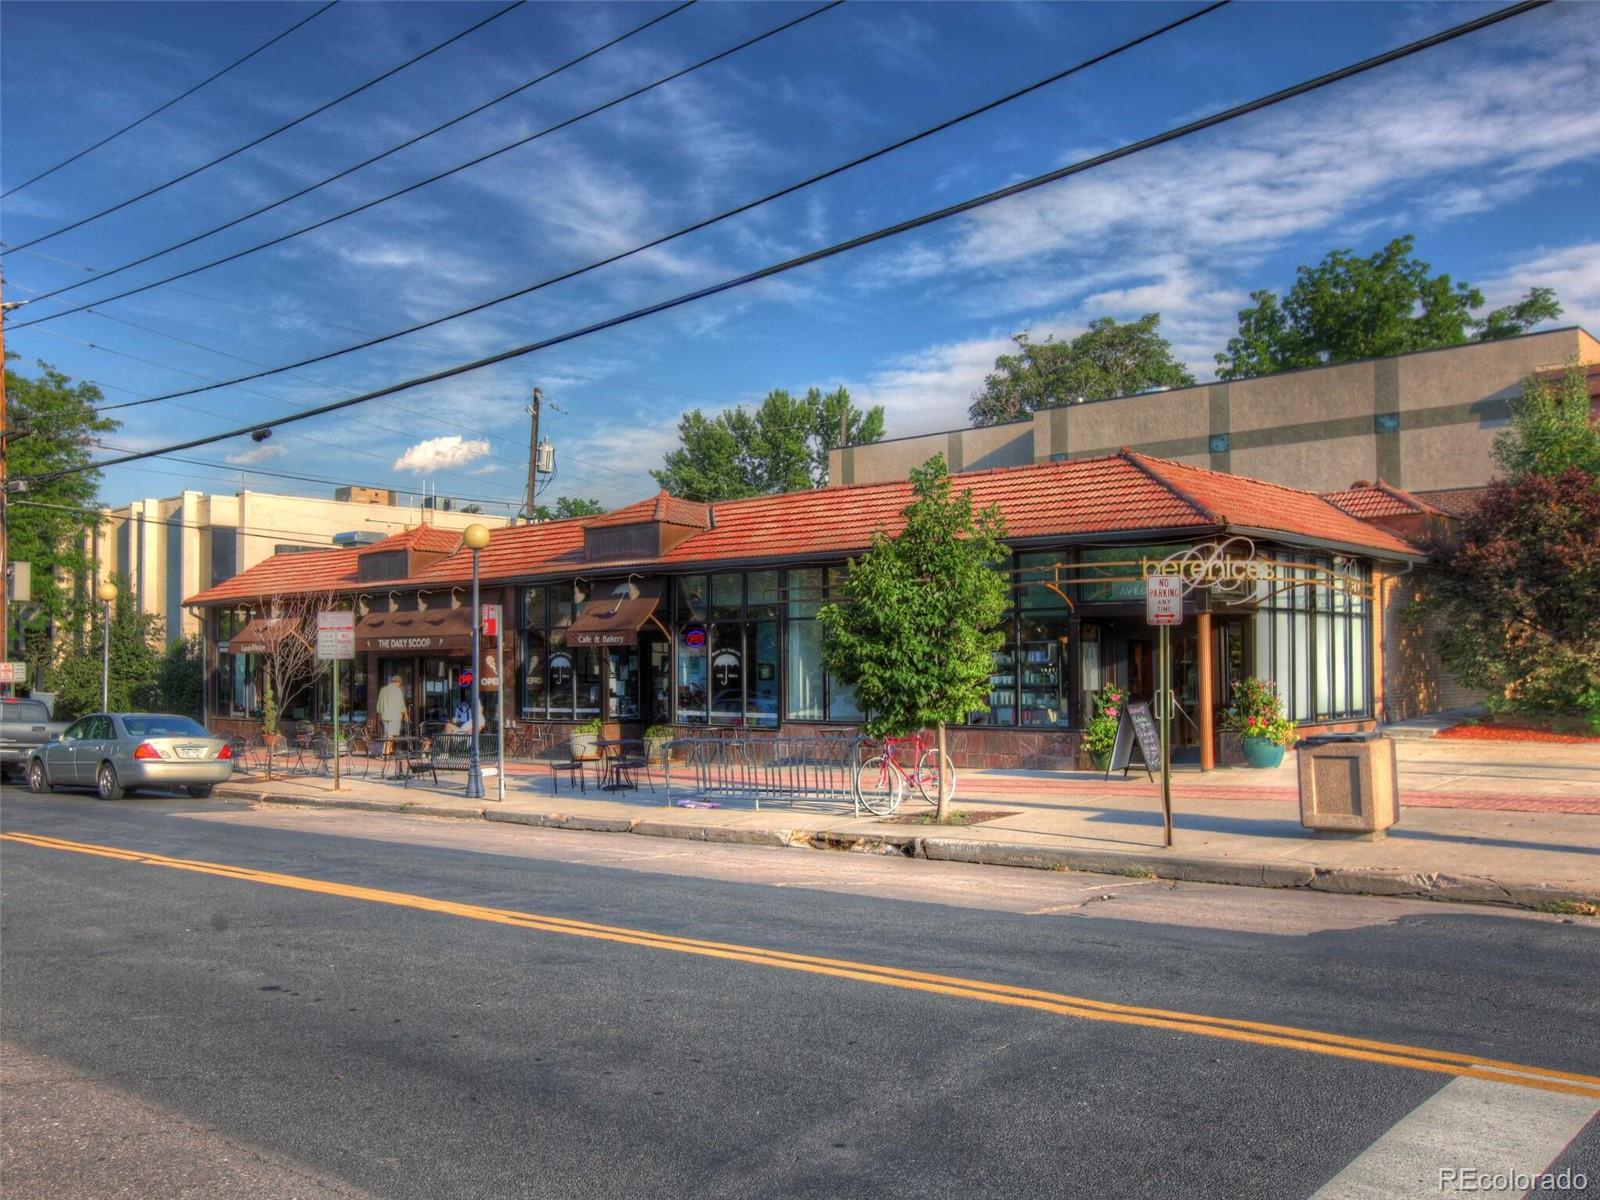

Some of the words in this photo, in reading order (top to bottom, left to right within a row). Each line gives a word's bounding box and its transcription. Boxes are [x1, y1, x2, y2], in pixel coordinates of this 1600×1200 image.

[1159, 579, 1168, 587] NO
[1149, 589, 1179, 598] PARKING
[379, 639, 390, 649] THE
[390, 639, 407, 649] DAILY
[408, 638, 431, 648] SCOOP
[577, 635, 592, 643] Cafe
[594, 635, 600, 643] &
[602, 634, 625, 645] Bakery
[481, 678, 498, 686] OPE
